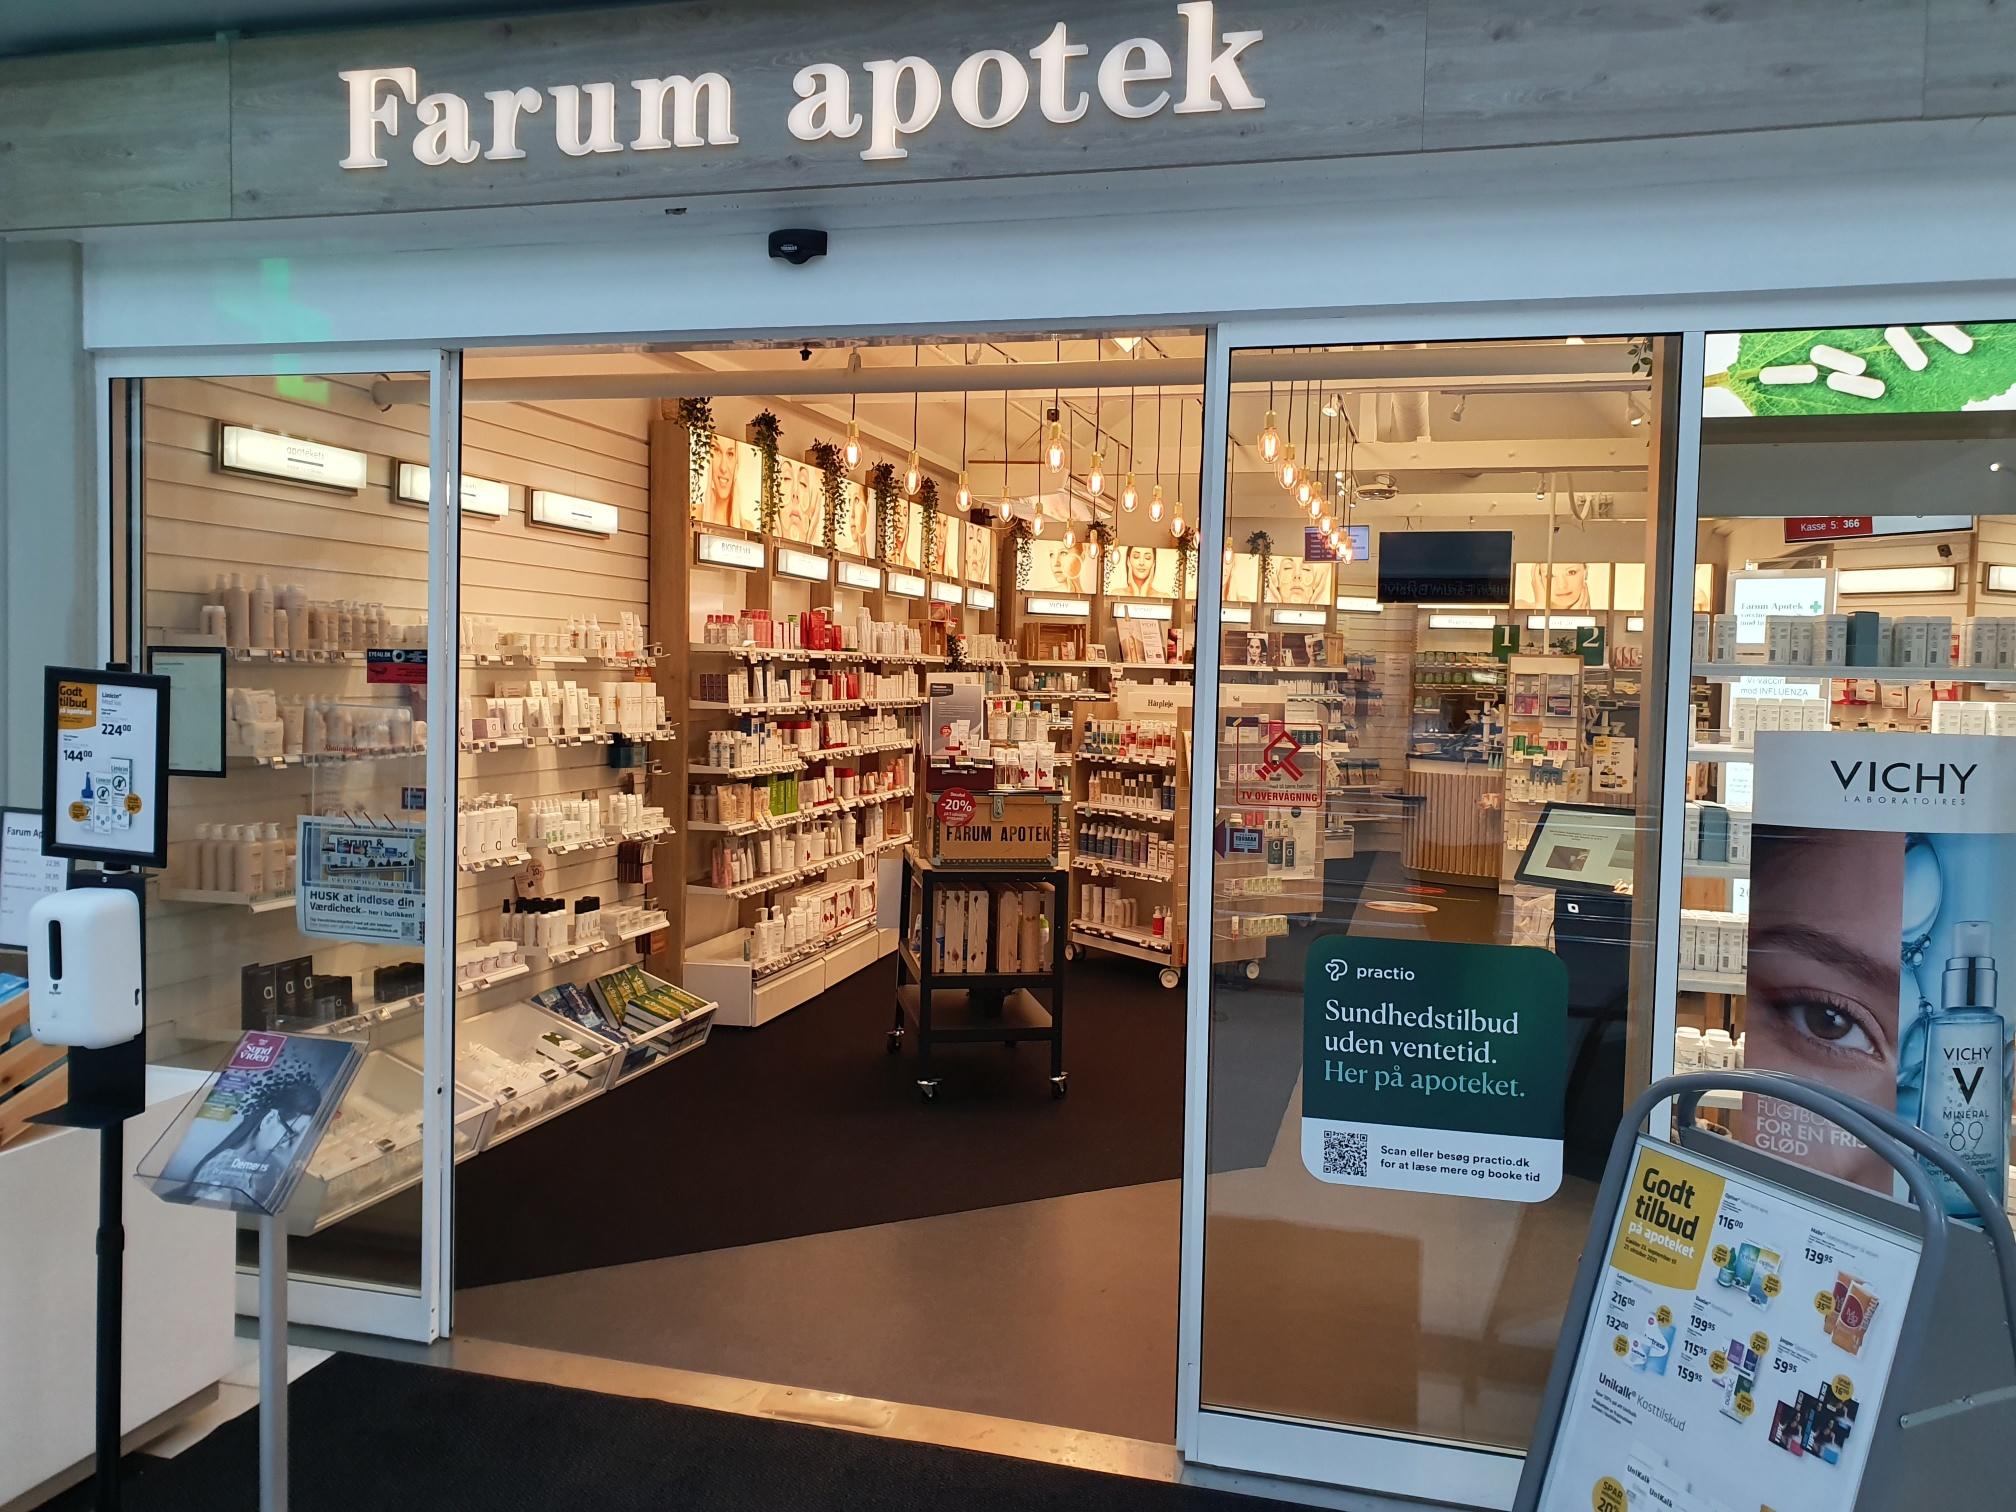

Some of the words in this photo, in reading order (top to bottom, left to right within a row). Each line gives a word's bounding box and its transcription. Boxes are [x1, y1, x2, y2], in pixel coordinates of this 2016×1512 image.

[339, 66, 739, 170] Farum
[787, 1, 1266, 161] apotek
[1800, 522, 1826, 532] Kasse
[1830, 520, 1839, 530] 5:
[1843, 519, 1860, 529] 366
[1501, 626, 1512, 647] 1
[1582, 626, 1599, 648] 2
[60, 685, 83, 697] Godt
[1741, 687, 1757, 695] mod
[1760, 688, 1808, 696] INFLUENZA
[60, 697, 88, 708] tilbud
[1148, 699, 1173, 709] Hårpleje
[1830, 760, 1978, 795] VICHY
[941, 799, 972, 812] -20%
[1241, 791, 1252, 799] TV
[1255, 789, 1318, 802] OVERVÅGNING
[1844, 796, 1966, 806] LABORATOIRES
[7, 827, 31, 837] Farum
[946, 825, 991, 841] FARUM
[1000, 825, 1051, 841] APOTEK
[310, 890, 340, 901] HUSK
[343, 893, 353, 902] at
[356, 894, 394, 906] indløse
[397, 897, 415, 908] din
[309, 901, 361, 914] Værdicheck
[368, 908, 379, 916] her
[384, 910, 415, 919] butikken!
[1356, 965, 1416, 981] practio
[1325, 999, 1519, 1035] Sundhedstilbud
[247, 1043, 273, 1054] Sund
[1324, 1031, 1384, 1055] uden
[1390, 1039, 1497, 1064] ventetid.
[1944, 1047, 1993, 1061] VICHY
[1324, 1060, 1368, 1084] Her
[1374, 1065, 1404, 1091] på
[1410, 1071, 1525, 1098] apoteket.
[1952, 1067, 1984, 1105] V
[1943, 1109, 1990, 1120] MINERAL
[1757, 1117, 1791, 1138] FOR
[1798, 1125, 1823, 1143] EN
[1949, 1121, 1984, 1151] 89
[1755, 1133, 1809, 1156] GLØD
[1380, 1145, 1407, 1157] Scan
[1410, 1147, 1435, 1160] eller
[1437, 1149, 1470, 1164] besøg
[1472, 1153, 1530, 1168] practio.dk
[1380, 1159, 1397, 1169] for
[1398, 1161, 1409, 1170] at
[1411, 1162, 1437, 1173] læse
[1440, 1166, 1468, 1176] mere
[1470, 1168, 1485, 1180] og
[1488, 1168, 1522, 1181] booke
[1524, 1172, 1540, 1183] tid
[1643, 1168, 1695, 1209] Godt
[1635, 1195, 1700, 1241] tilbud
[1628, 1221, 1642, 1234] på
[1644, 1227, 1695, 1259] apoteket
[1637, 1395, 1687, 1432] Kosttilskud
[1603, 1481, 1624, 1500] SPAR
